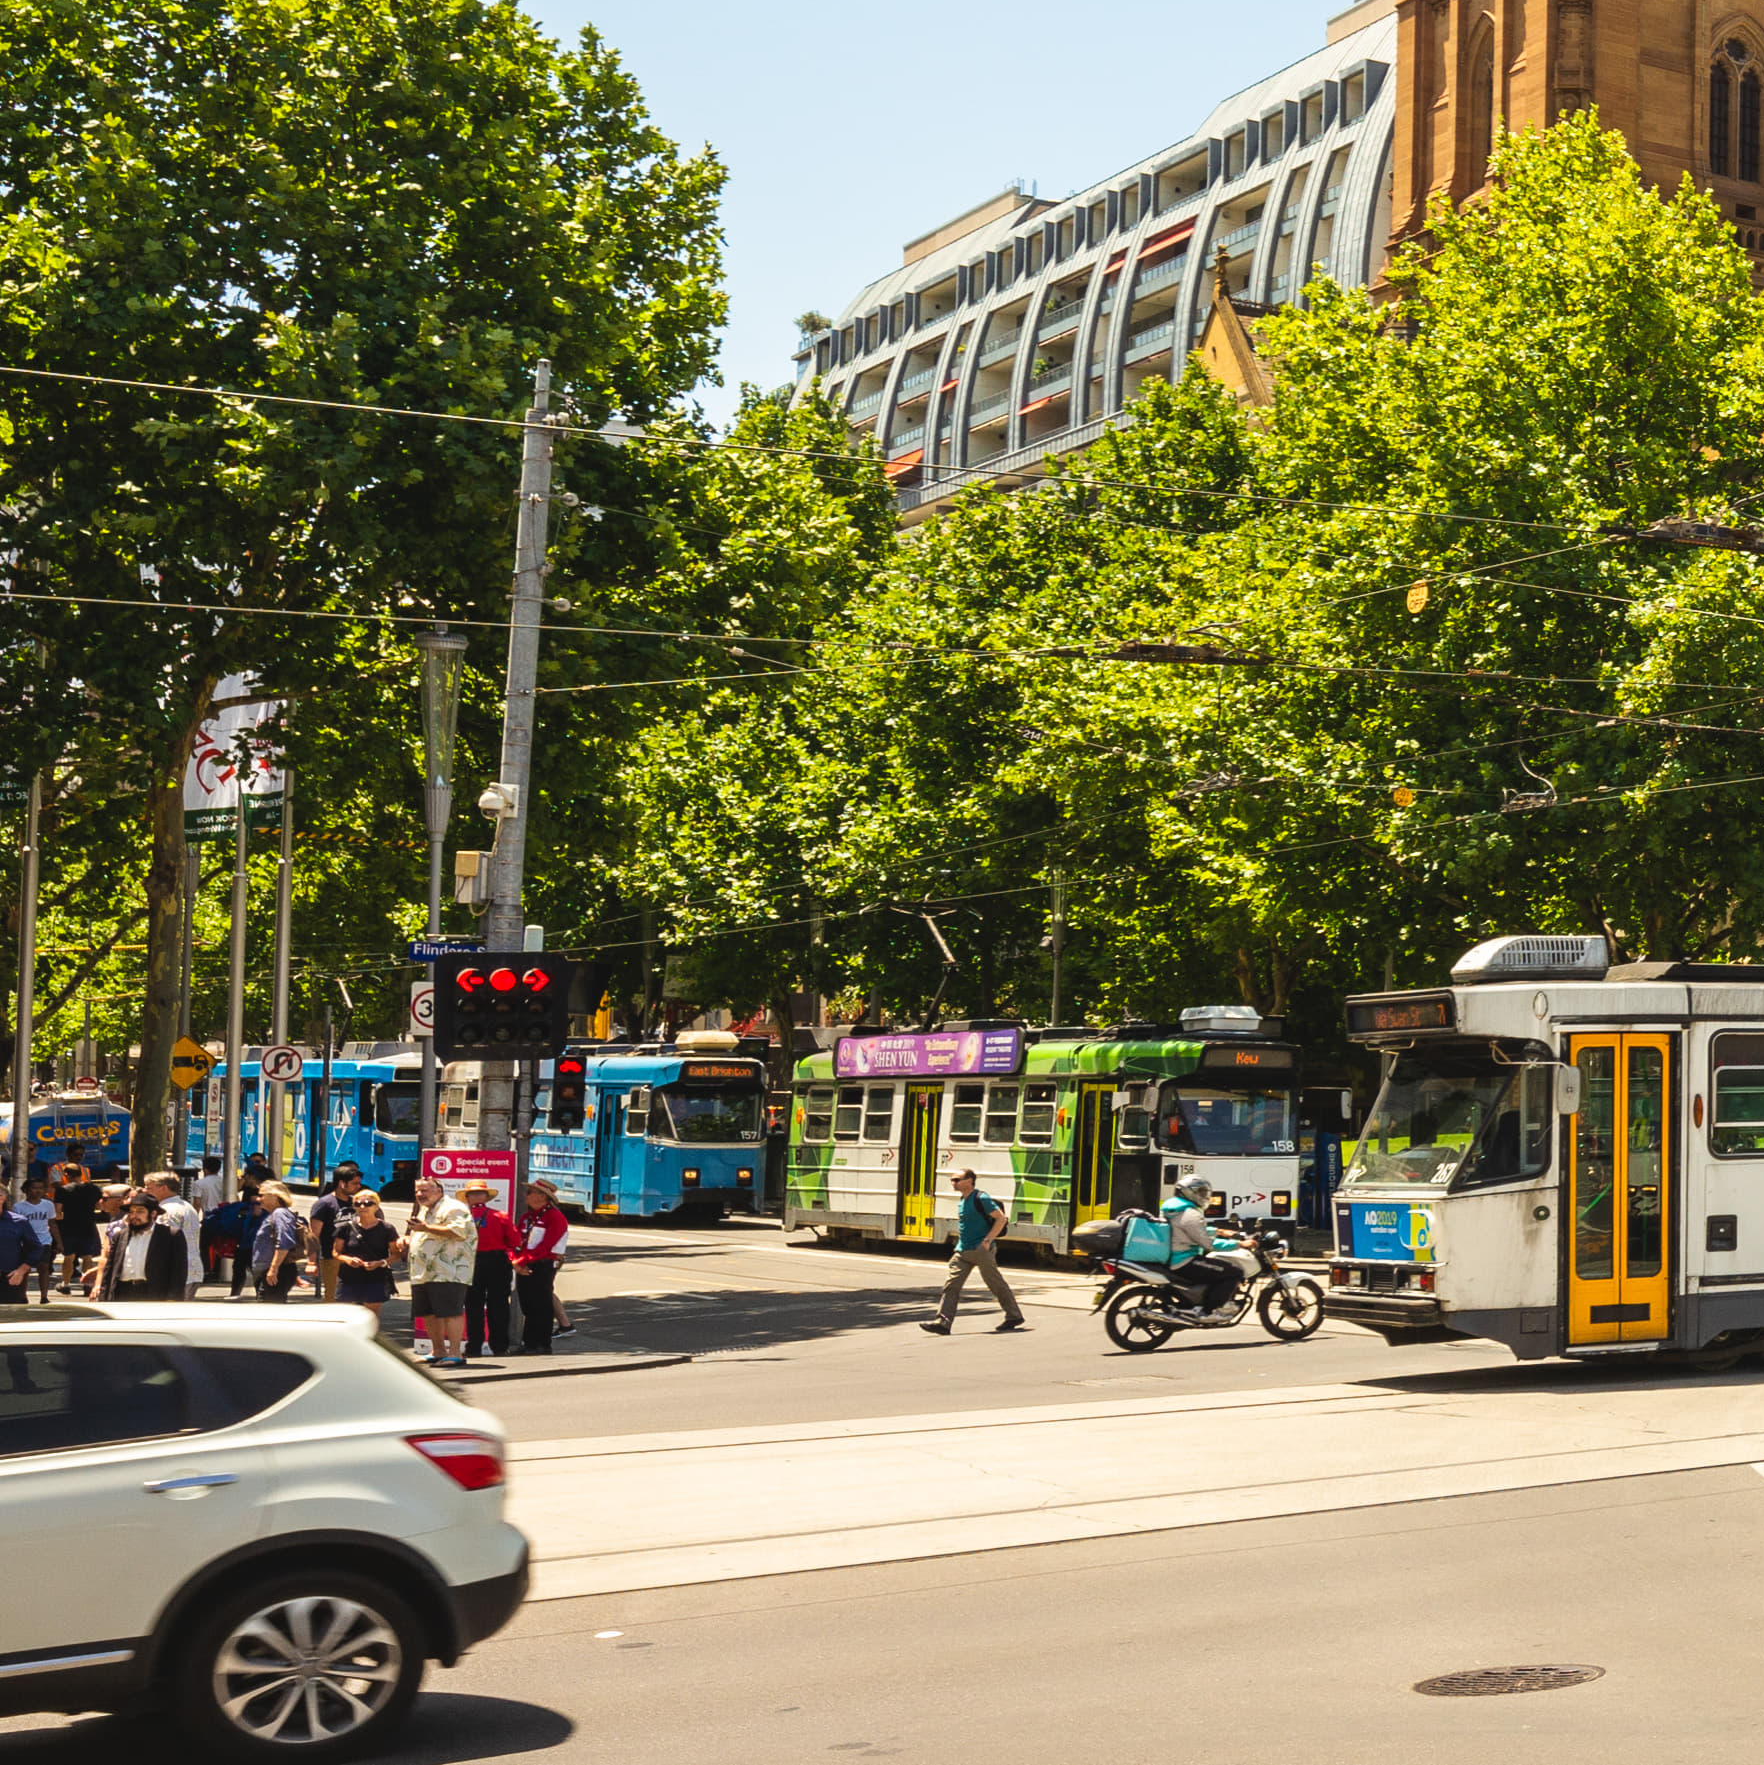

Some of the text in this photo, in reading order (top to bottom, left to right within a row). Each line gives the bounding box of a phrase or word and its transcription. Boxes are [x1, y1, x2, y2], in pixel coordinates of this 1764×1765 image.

[418, 999, 433, 1018] 3
[874, 1051, 897, 1068] SHEN
[898, 1051, 918, 1067] YUN
[1235, 1051, 1259, 1065] Kew
[688, 1065, 751, 1077] East Brighton
[741, 1130, 758, 1141] 157
[1272, 1140, 1295, 1152] 158
[456, 1157, 486, 1167] Special
[1180, 1164, 1195, 1175] 158
[1430, 1162, 1458, 1184] 267
